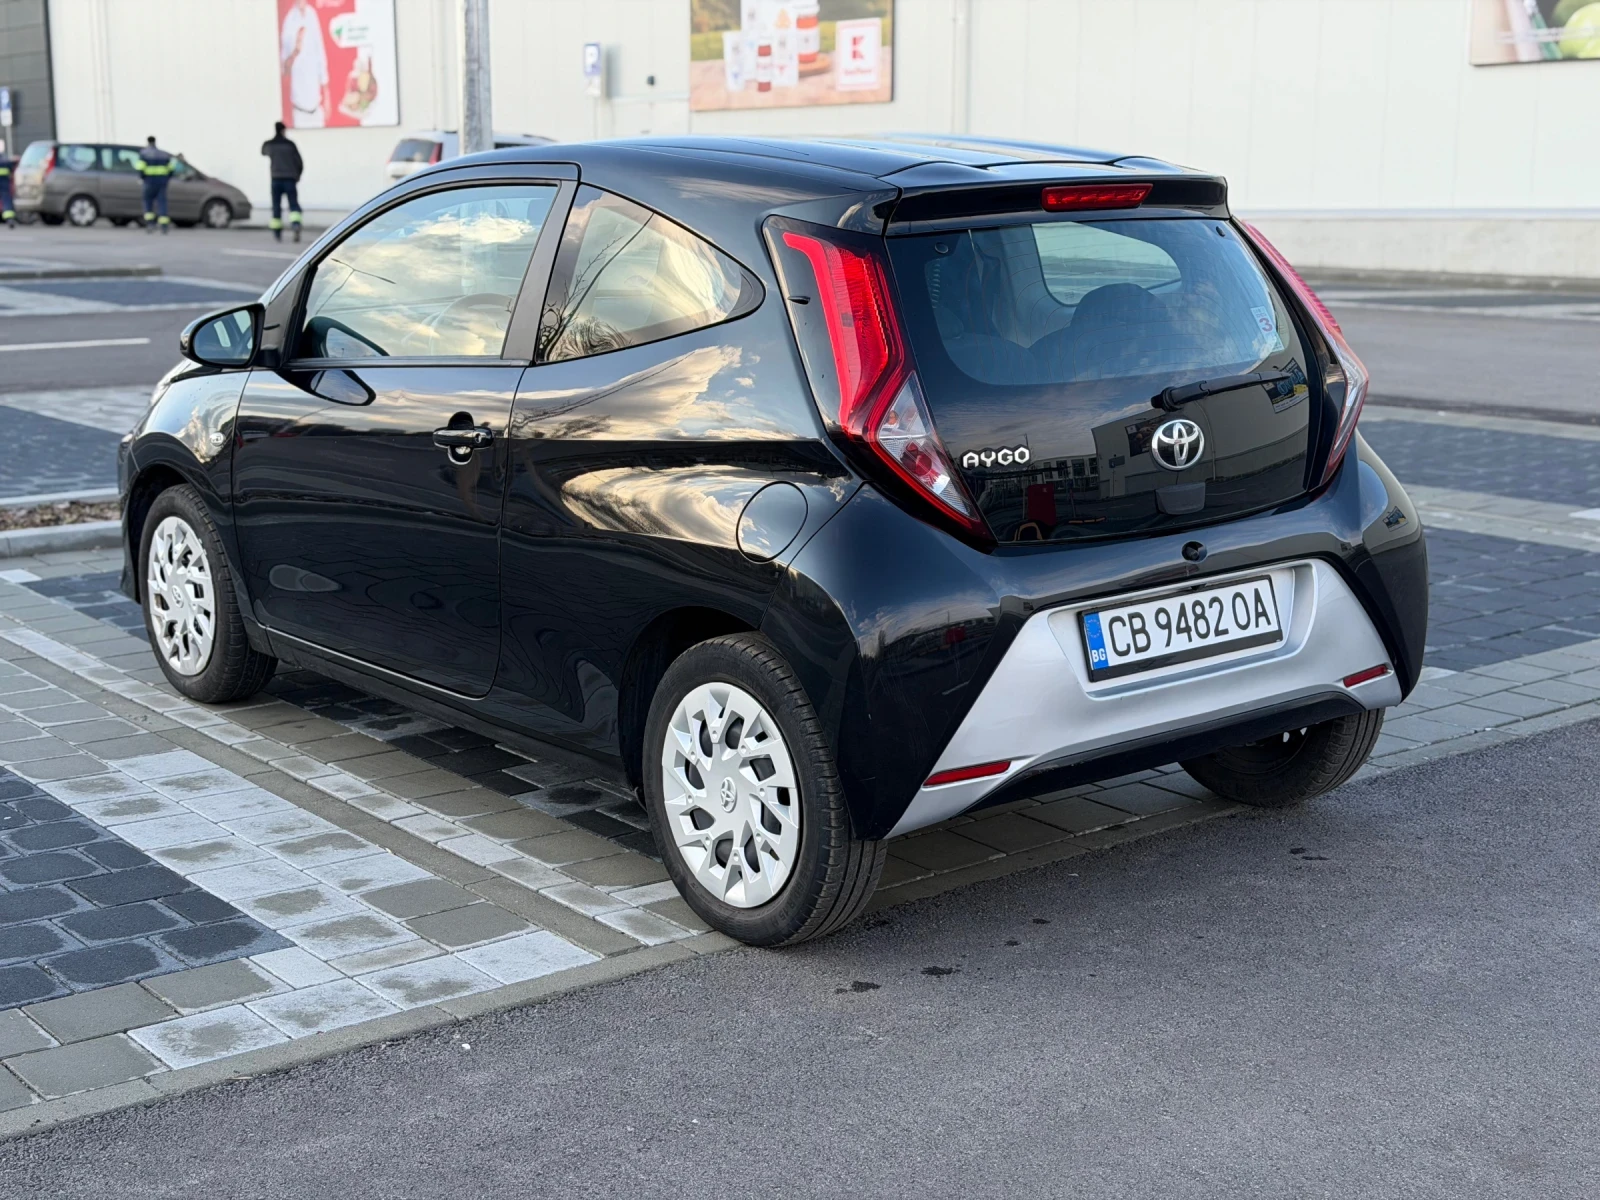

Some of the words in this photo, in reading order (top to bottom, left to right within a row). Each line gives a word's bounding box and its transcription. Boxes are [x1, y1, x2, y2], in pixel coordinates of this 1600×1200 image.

[1259, 317, 1273, 332] 3
[962, 446, 1030, 469] AYGO
[1108, 611, 1151, 657] CB
[1154, 596, 1229, 648] 9482
[1231, 587, 1272, 631] OA
[1091, 648, 1107, 663] BG
